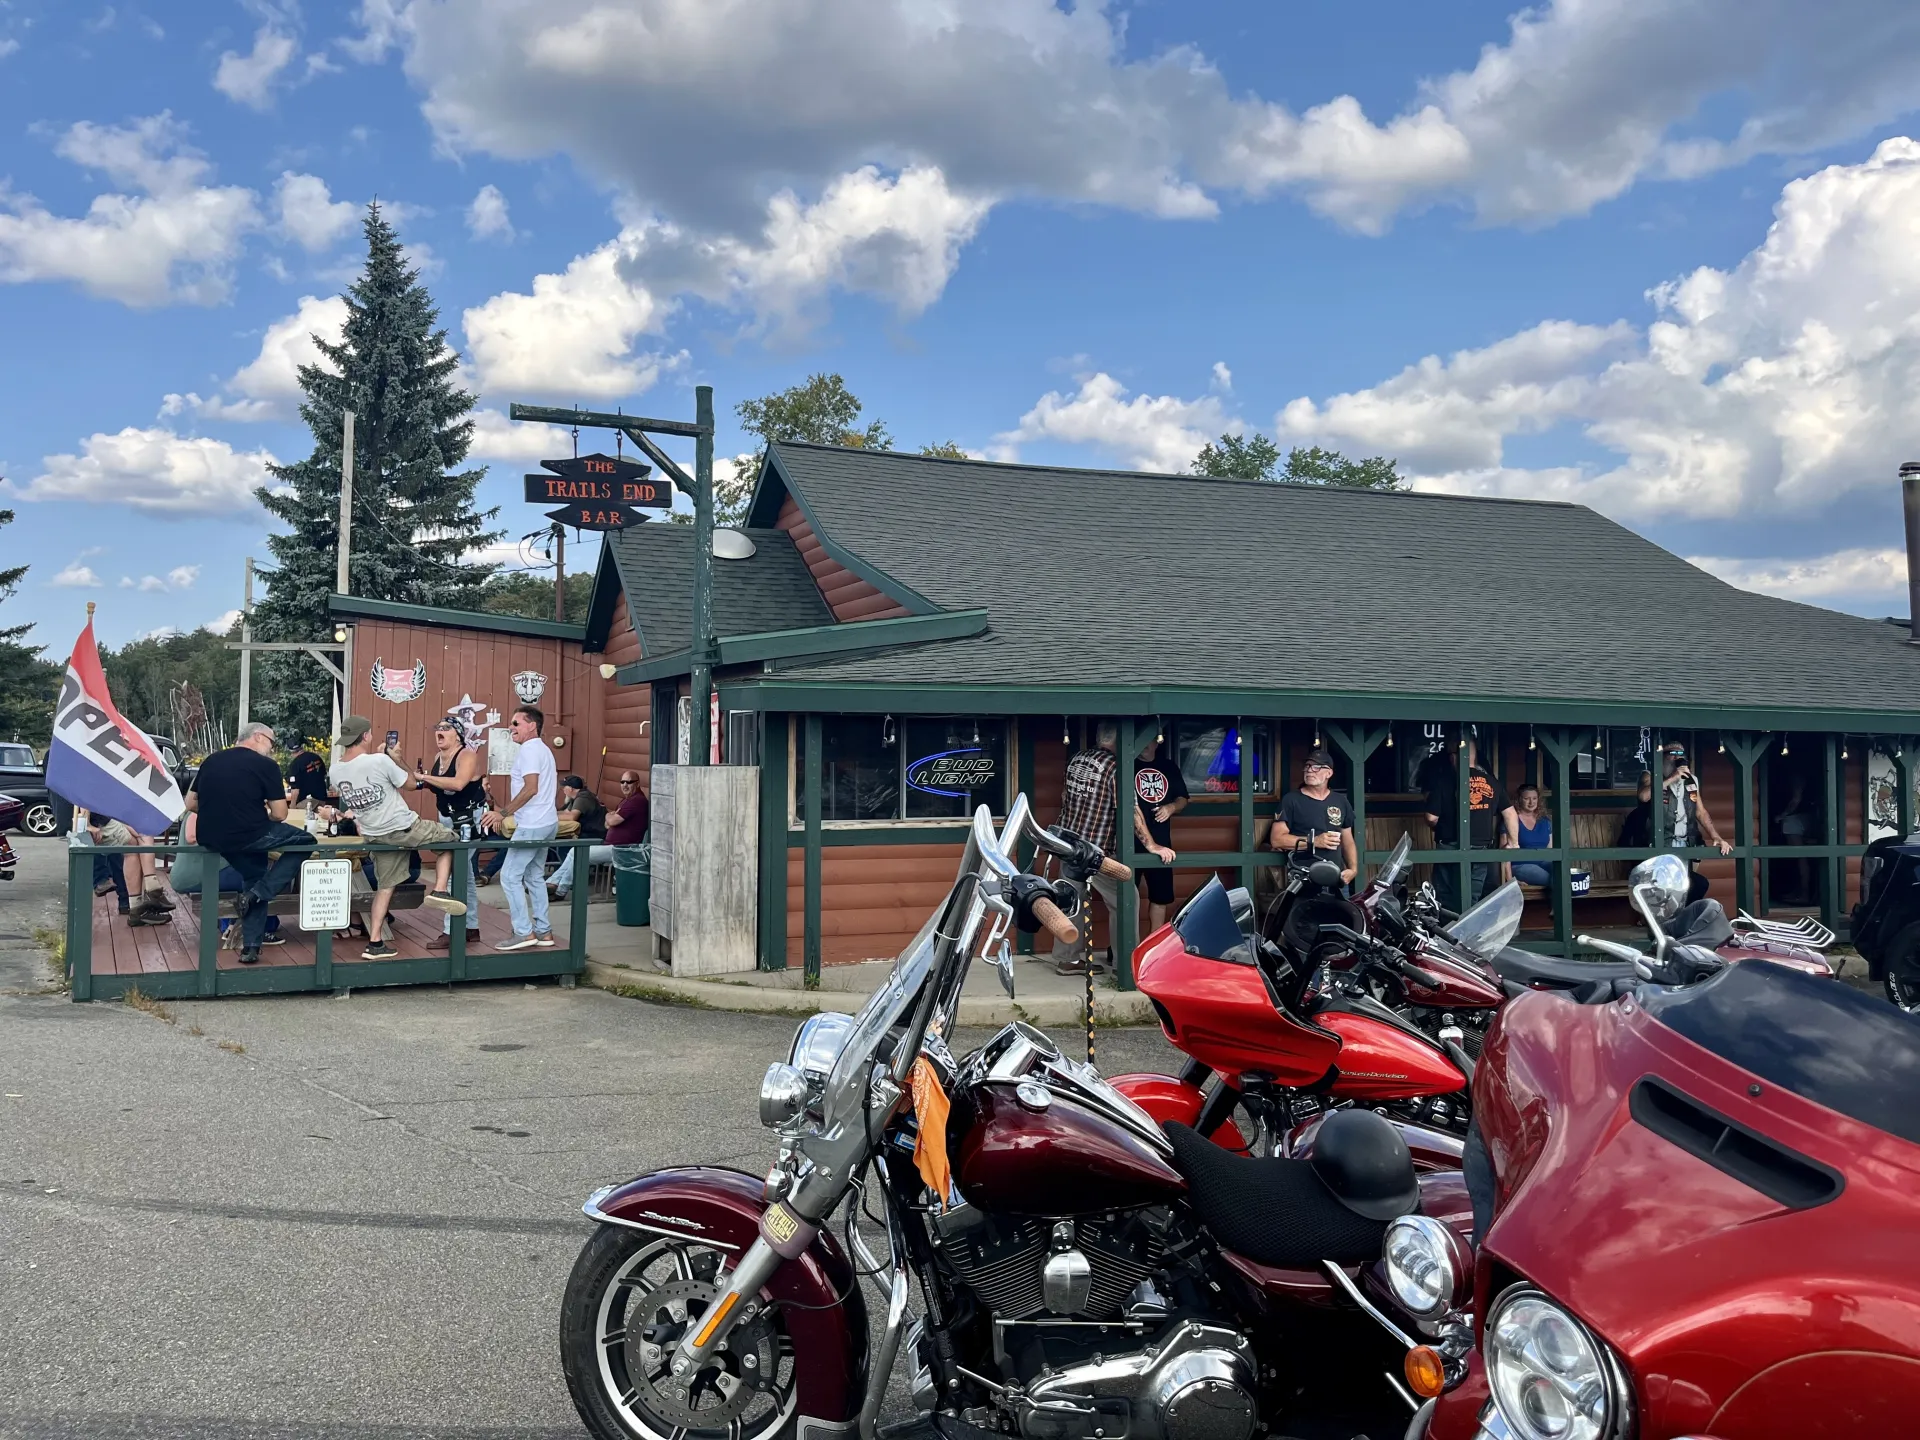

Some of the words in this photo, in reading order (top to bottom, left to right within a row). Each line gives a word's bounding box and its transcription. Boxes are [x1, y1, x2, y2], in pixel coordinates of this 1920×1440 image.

[584, 460, 617, 474] THE
[545, 480, 611, 498] TRAILS
[623, 484, 656, 502] END
[581, 510, 622, 525] BAR
[932, 758, 994, 772] BUD
[914, 771, 995, 785] LIGHT
[1204, 777, 1239, 792] Coors
[1571, 880, 1590, 891] Blu
